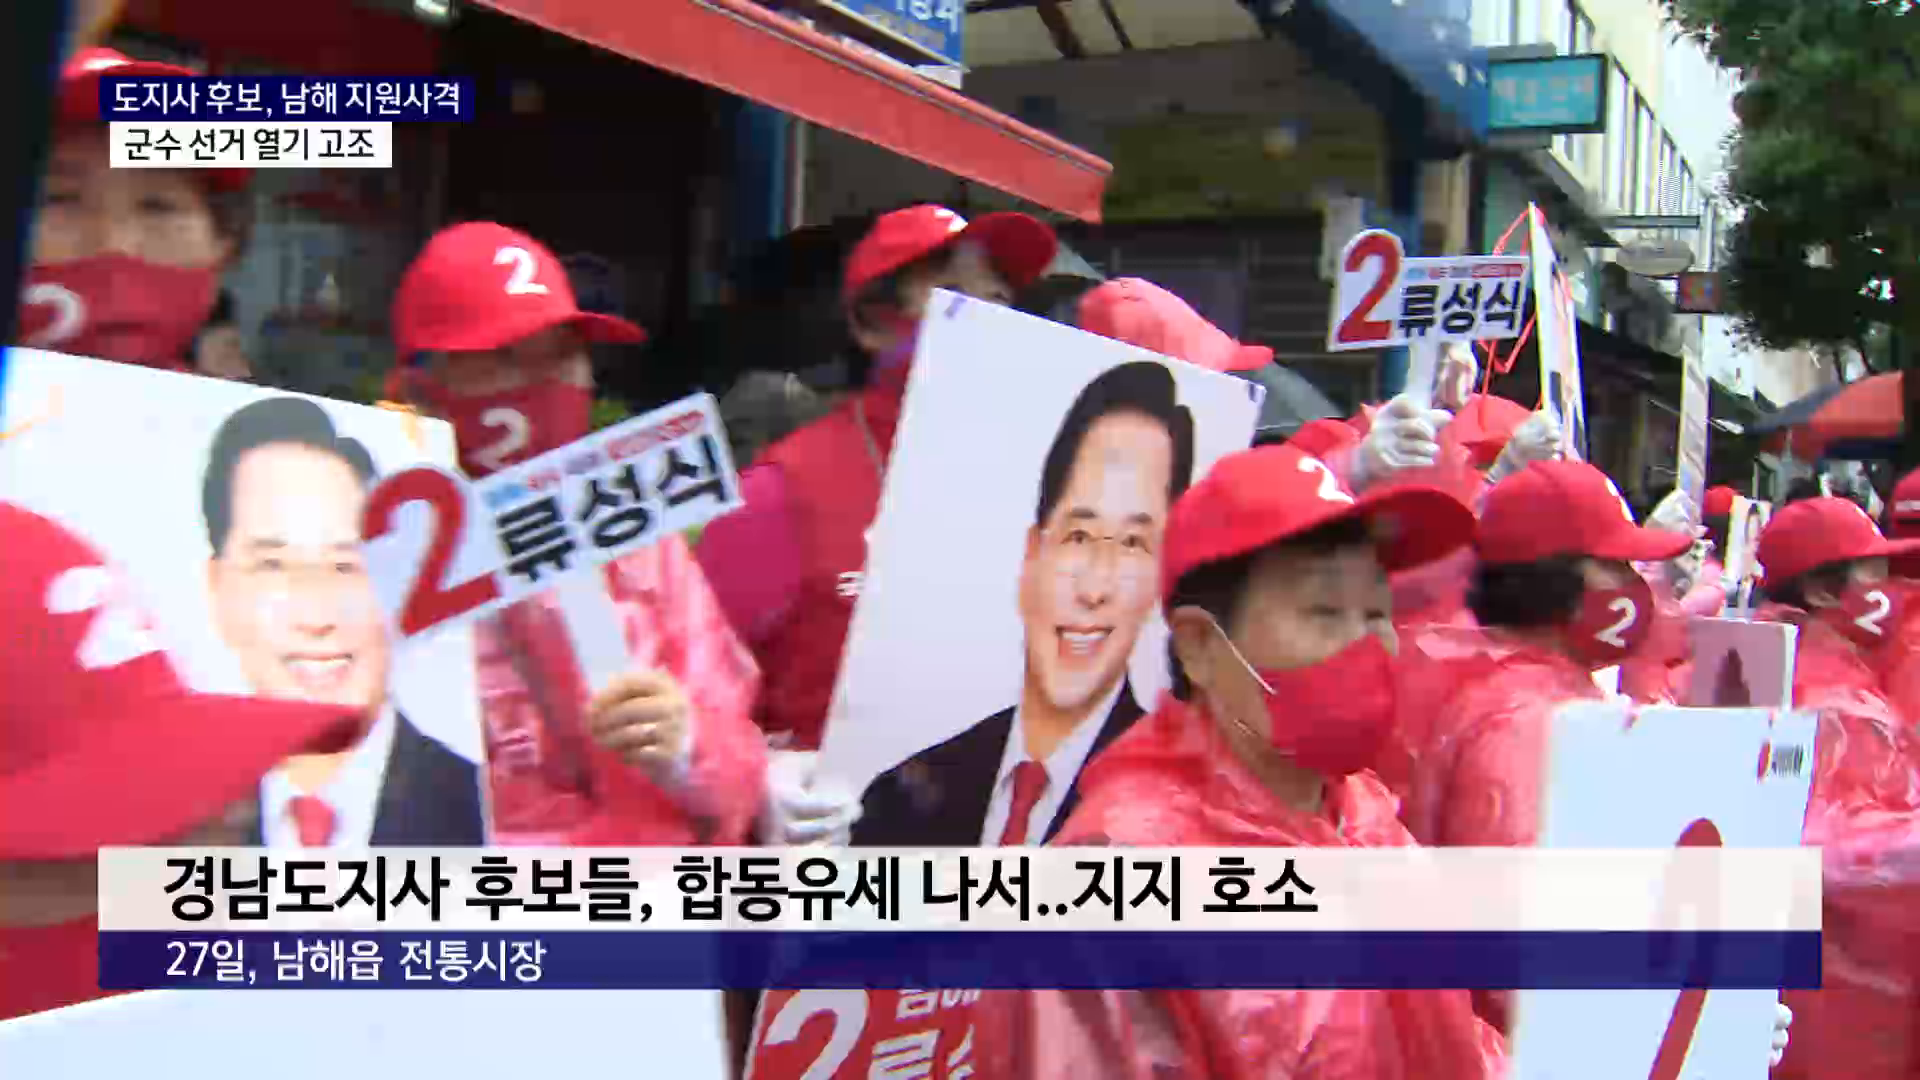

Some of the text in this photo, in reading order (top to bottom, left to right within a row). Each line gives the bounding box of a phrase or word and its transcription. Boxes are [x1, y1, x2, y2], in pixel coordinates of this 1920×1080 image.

[492, 246, 550, 295] 2
[1337, 233, 1521, 343] 2 류성식
[22, 282, 84, 346] 2
[470, 407, 530, 471] 2
[1297, 455, 1355, 505] 2
[364, 467, 500, 636] 2
[495, 433, 729, 582] 류성식
[1594, 597, 1637, 647] 2
[1854, 590, 1891, 636] 2
